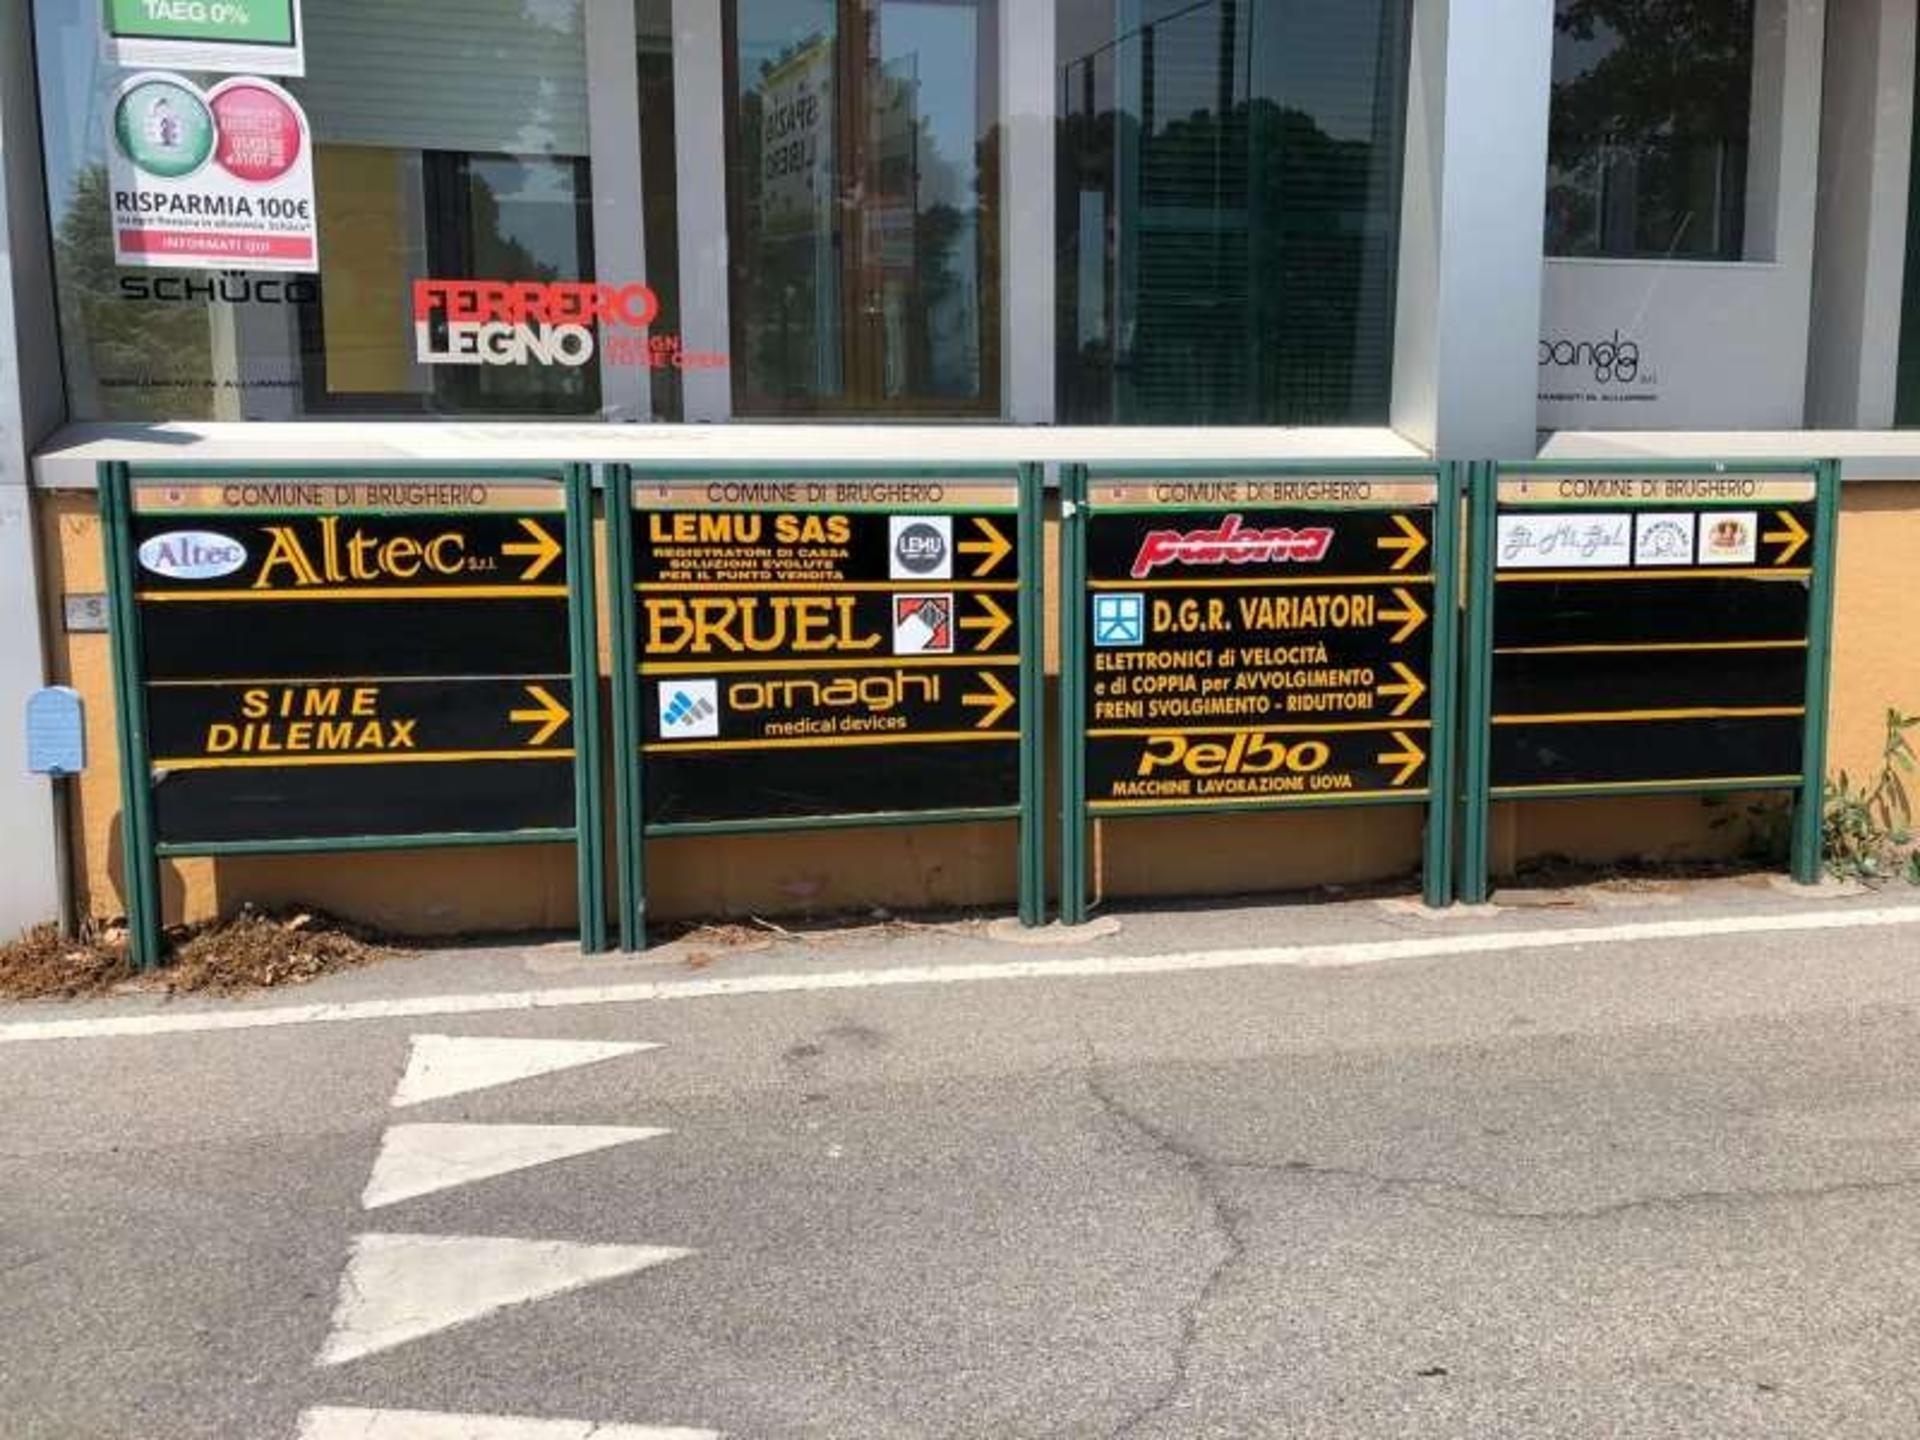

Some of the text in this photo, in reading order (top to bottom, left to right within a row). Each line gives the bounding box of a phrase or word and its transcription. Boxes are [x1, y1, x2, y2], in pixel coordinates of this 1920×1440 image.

[145, 0, 249, 25] TAEG 0%
[115, 191, 309, 220] RISPARMIA 100€
[162, 237, 242, 252] INFORMATI
[119, 271, 318, 303] SCHÜCO
[414, 280, 660, 327] FERRERO
[416, 322, 594, 366] LEGNO
[223, 483, 487, 506] COMUNE DI BRUGHERIO
[707, 483, 944, 503] COMUNE DI BRUGHERIO
[1156, 482, 1371, 502] COMUNE DI BRUGHERIO
[1559, 480, 1756, 498] COMUNE DI BRUGHERIO
[650, 513, 851, 543] LEMU SAS
[155, 537, 240, 568] Altec
[252, 516, 464, 588] Altec
[654, 549, 848, 558] REGISTRATORI DI CASSA
[899, 537, 941, 553] LEMU
[659, 571, 692, 580] PER
[716, 571, 772, 580] PUNTO
[776, 571, 844, 580] VENDITA
[669, 559, 834, 569] SOLUZIONI EVOLUTE
[644, 597, 881, 653] BRUEL
[1153, 594, 1374, 633] D.G.R. VARIATORI
[1096, 642, 1328, 671] ELETTRONICI di VELOCITÀ
[729, 669, 940, 711] ornaghi
[1094, 669, 1375, 696] e di COPPIA per AVVOLGIMENTO
[242, 688, 379, 718] SIME
[1096, 701, 1143, 718] FRENI
[1150, 696, 1270, 716] SVOLGIMENTO
[1287, 692, 1373, 711] RIDUTTORI
[207, 719, 416, 752] DILEMAX
[765, 713, 907, 735] medical devices
[1138, 734, 1330, 776] Pelbo
[1112, 774, 1352, 796] MACCHINE LAVORAZIONE UOVA
